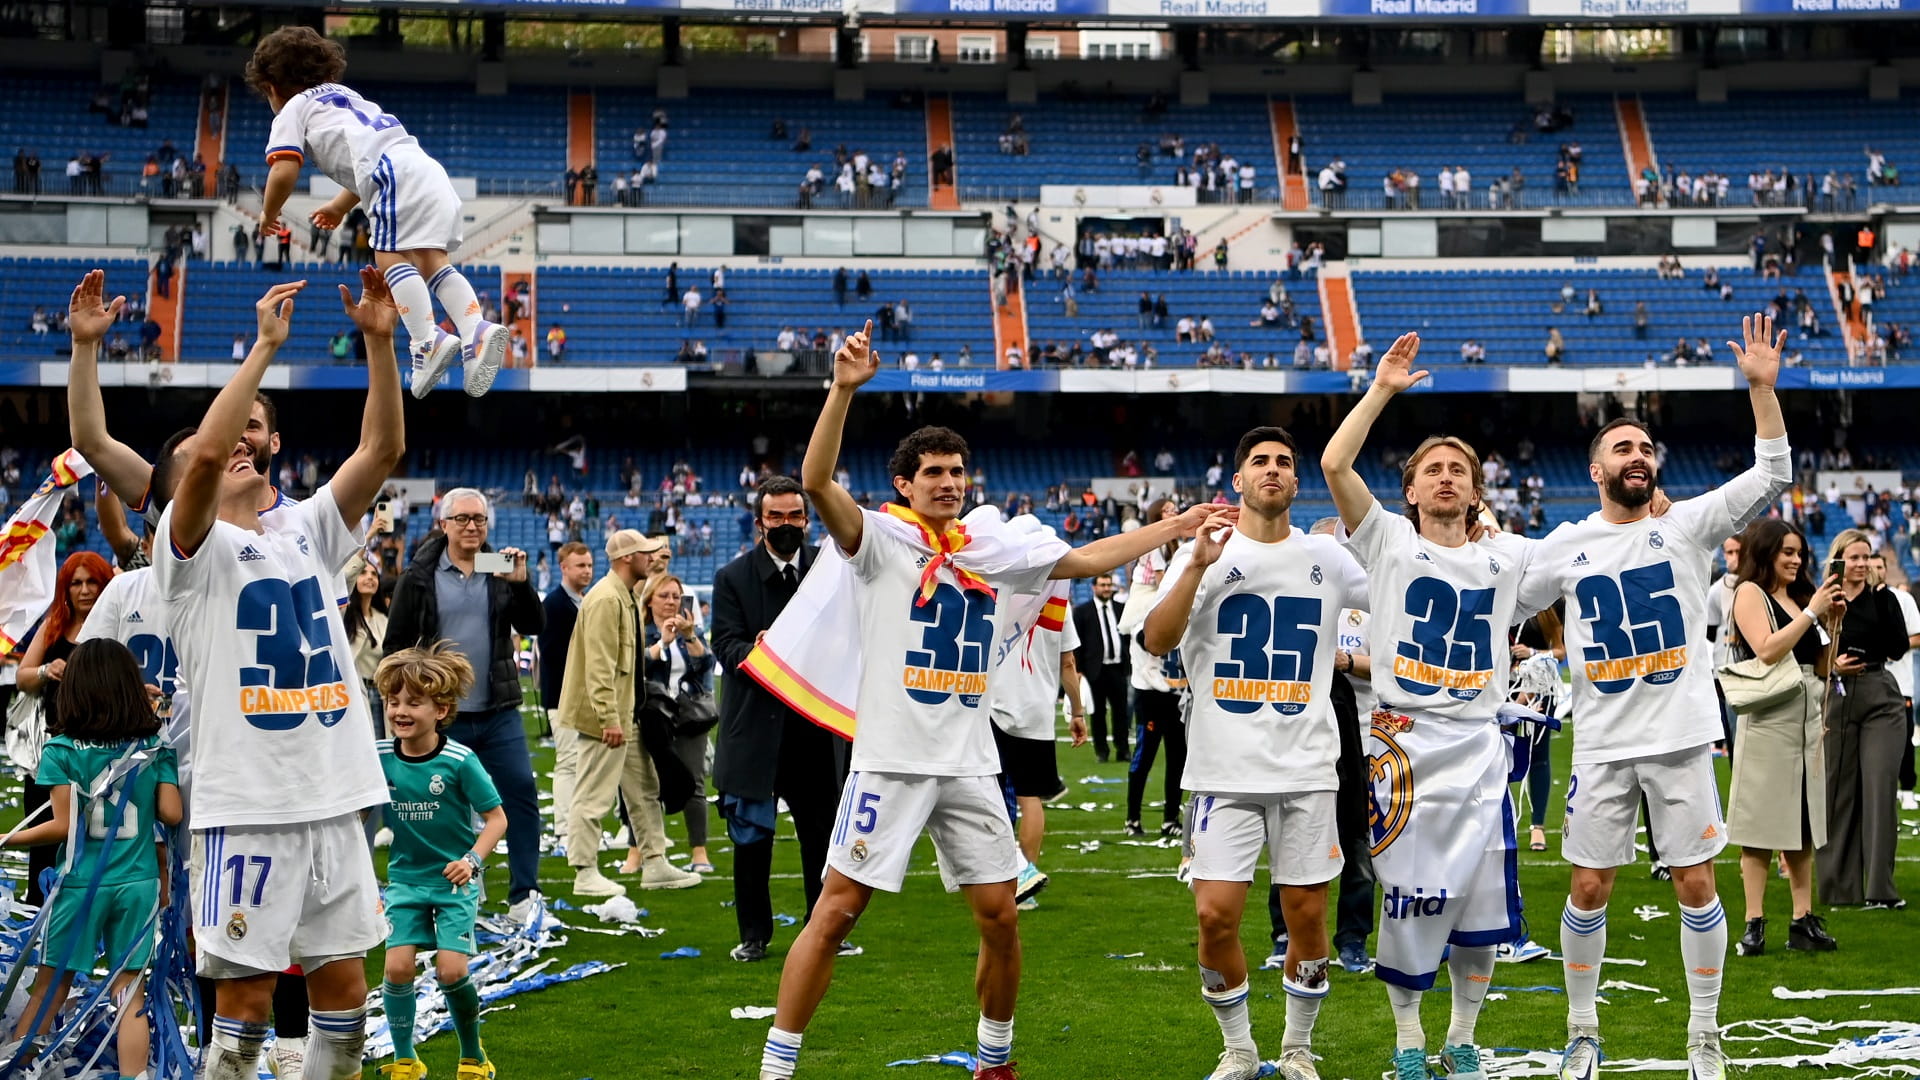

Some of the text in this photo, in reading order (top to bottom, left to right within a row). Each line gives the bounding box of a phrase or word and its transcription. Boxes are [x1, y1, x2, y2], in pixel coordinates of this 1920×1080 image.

[735, 0, 843, 9] Real Madrid
[949, 0, 1057, 12] Real Madrid
[1161, 0, 1266, 14] Real Madrid
[1371, 0, 1477, 13] Real Madrid
[1581, 0, 1688, 11] Real Madrid
[1792, 0, 1900, 10] Real Madrid
[911, 375, 984, 387] Real Madrid
[1810, 371, 1884, 384] Real Madrid
[238, 553, 266, 562] adidas
[1575, 560, 1687, 695] 35
[1396, 576, 1496, 701] 35
[905, 583, 998, 708] 35
[236, 575, 347, 730] 35
[1214, 593, 1322, 716] 35
[1585, 647, 1688, 681] CAMPEONES
[1393, 656, 1494, 690] CAMPEONES
[1652, 671, 1675, 682] 2022
[1213, 679, 1312, 703] CAMPEONES
[391, 801, 440, 811] Emirates
[853, 791, 881, 834] 5
[398, 811, 433, 821] FLY BETTER
[224, 854, 272, 908] 17
